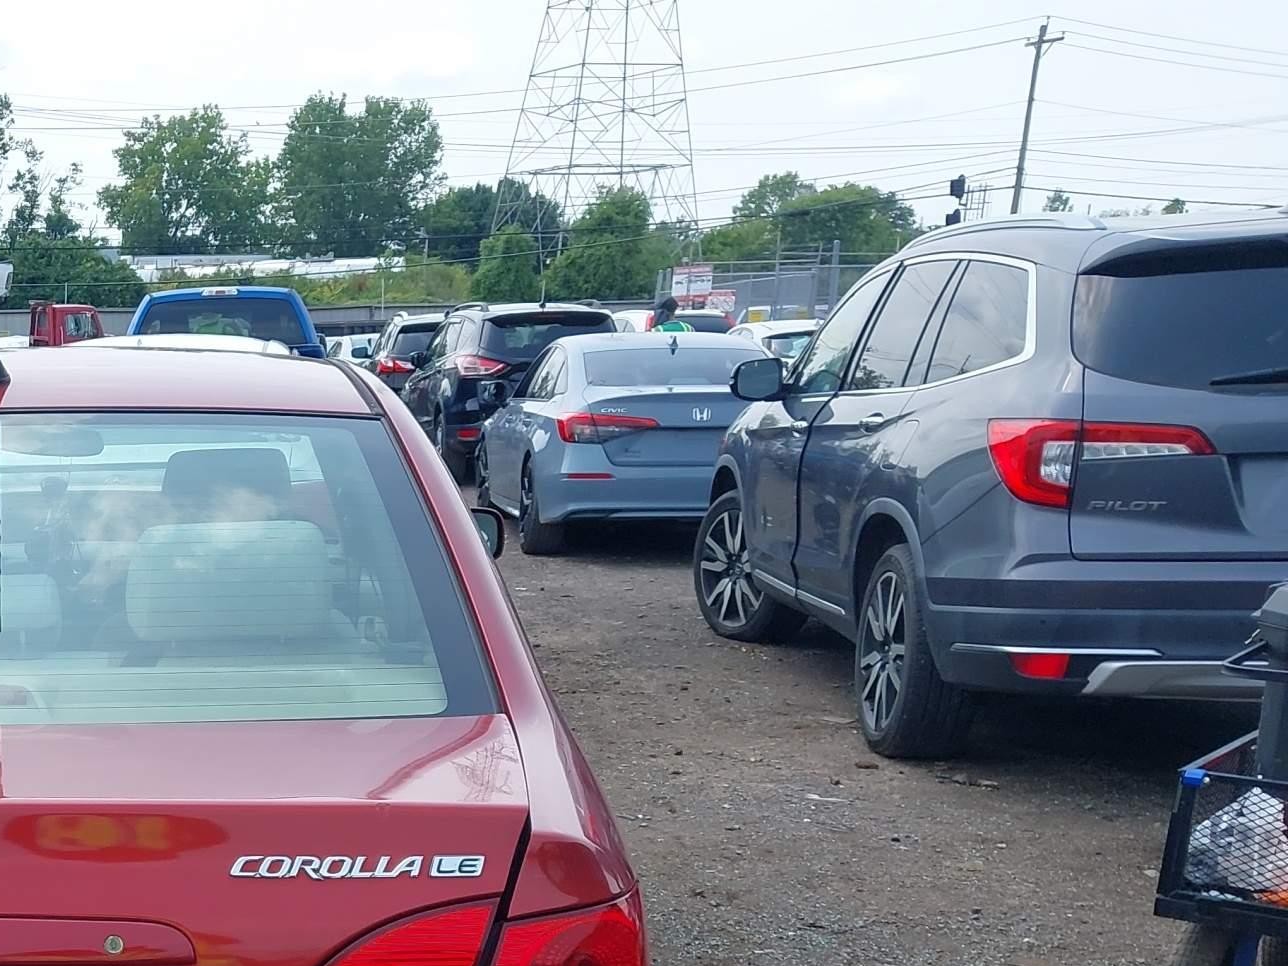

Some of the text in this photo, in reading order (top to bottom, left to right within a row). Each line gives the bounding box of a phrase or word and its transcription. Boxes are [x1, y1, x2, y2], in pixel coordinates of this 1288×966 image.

[1086, 500, 1169, 511] PILOT
[229, 855, 479, 880] COROLLA LE
